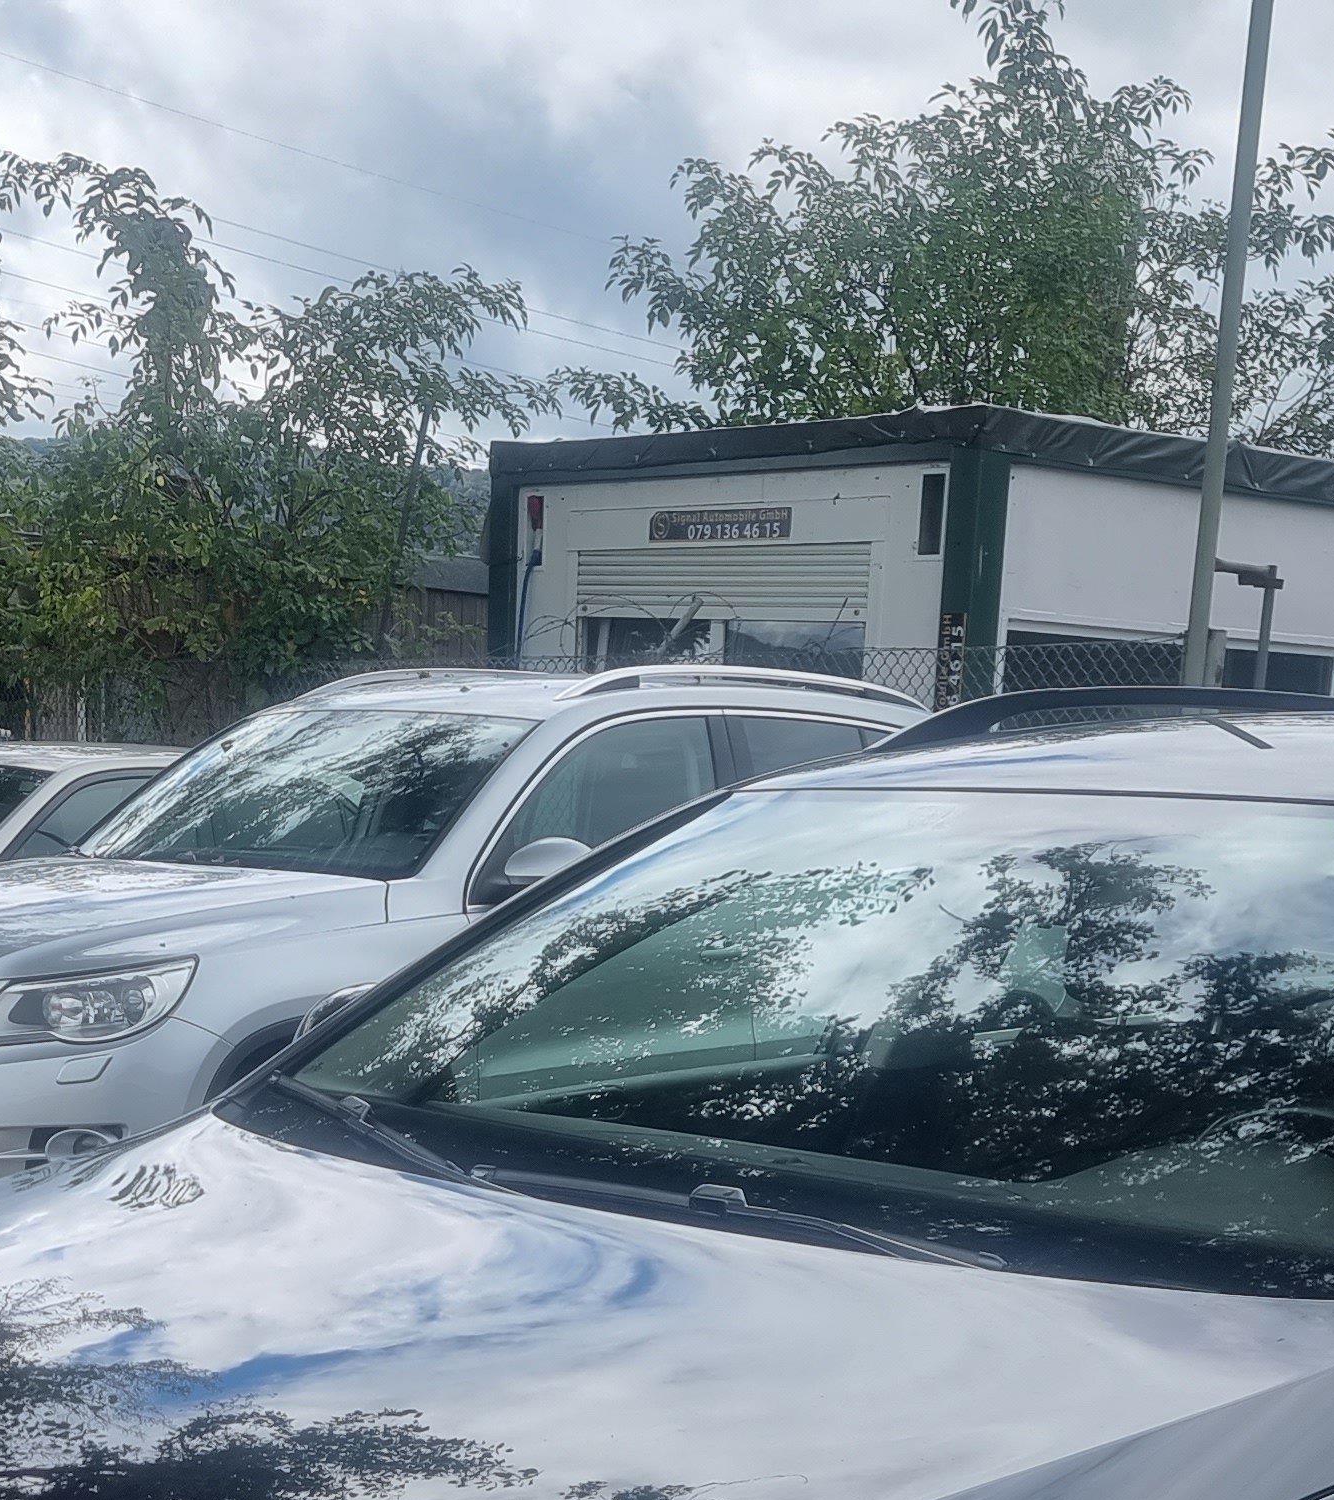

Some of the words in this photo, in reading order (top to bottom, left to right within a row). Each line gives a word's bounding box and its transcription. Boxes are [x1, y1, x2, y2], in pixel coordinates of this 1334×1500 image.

[671, 512, 700, 526] Signal
[703, 510, 756, 523] Automobile
[759, 508, 788, 521] GmbH
[687, 524, 712, 540] 079
[716, 523, 740, 539] 136
[743, 522, 760, 538] 46
[765, 521, 781, 538] 15
[950, 625, 964, 650] 15
